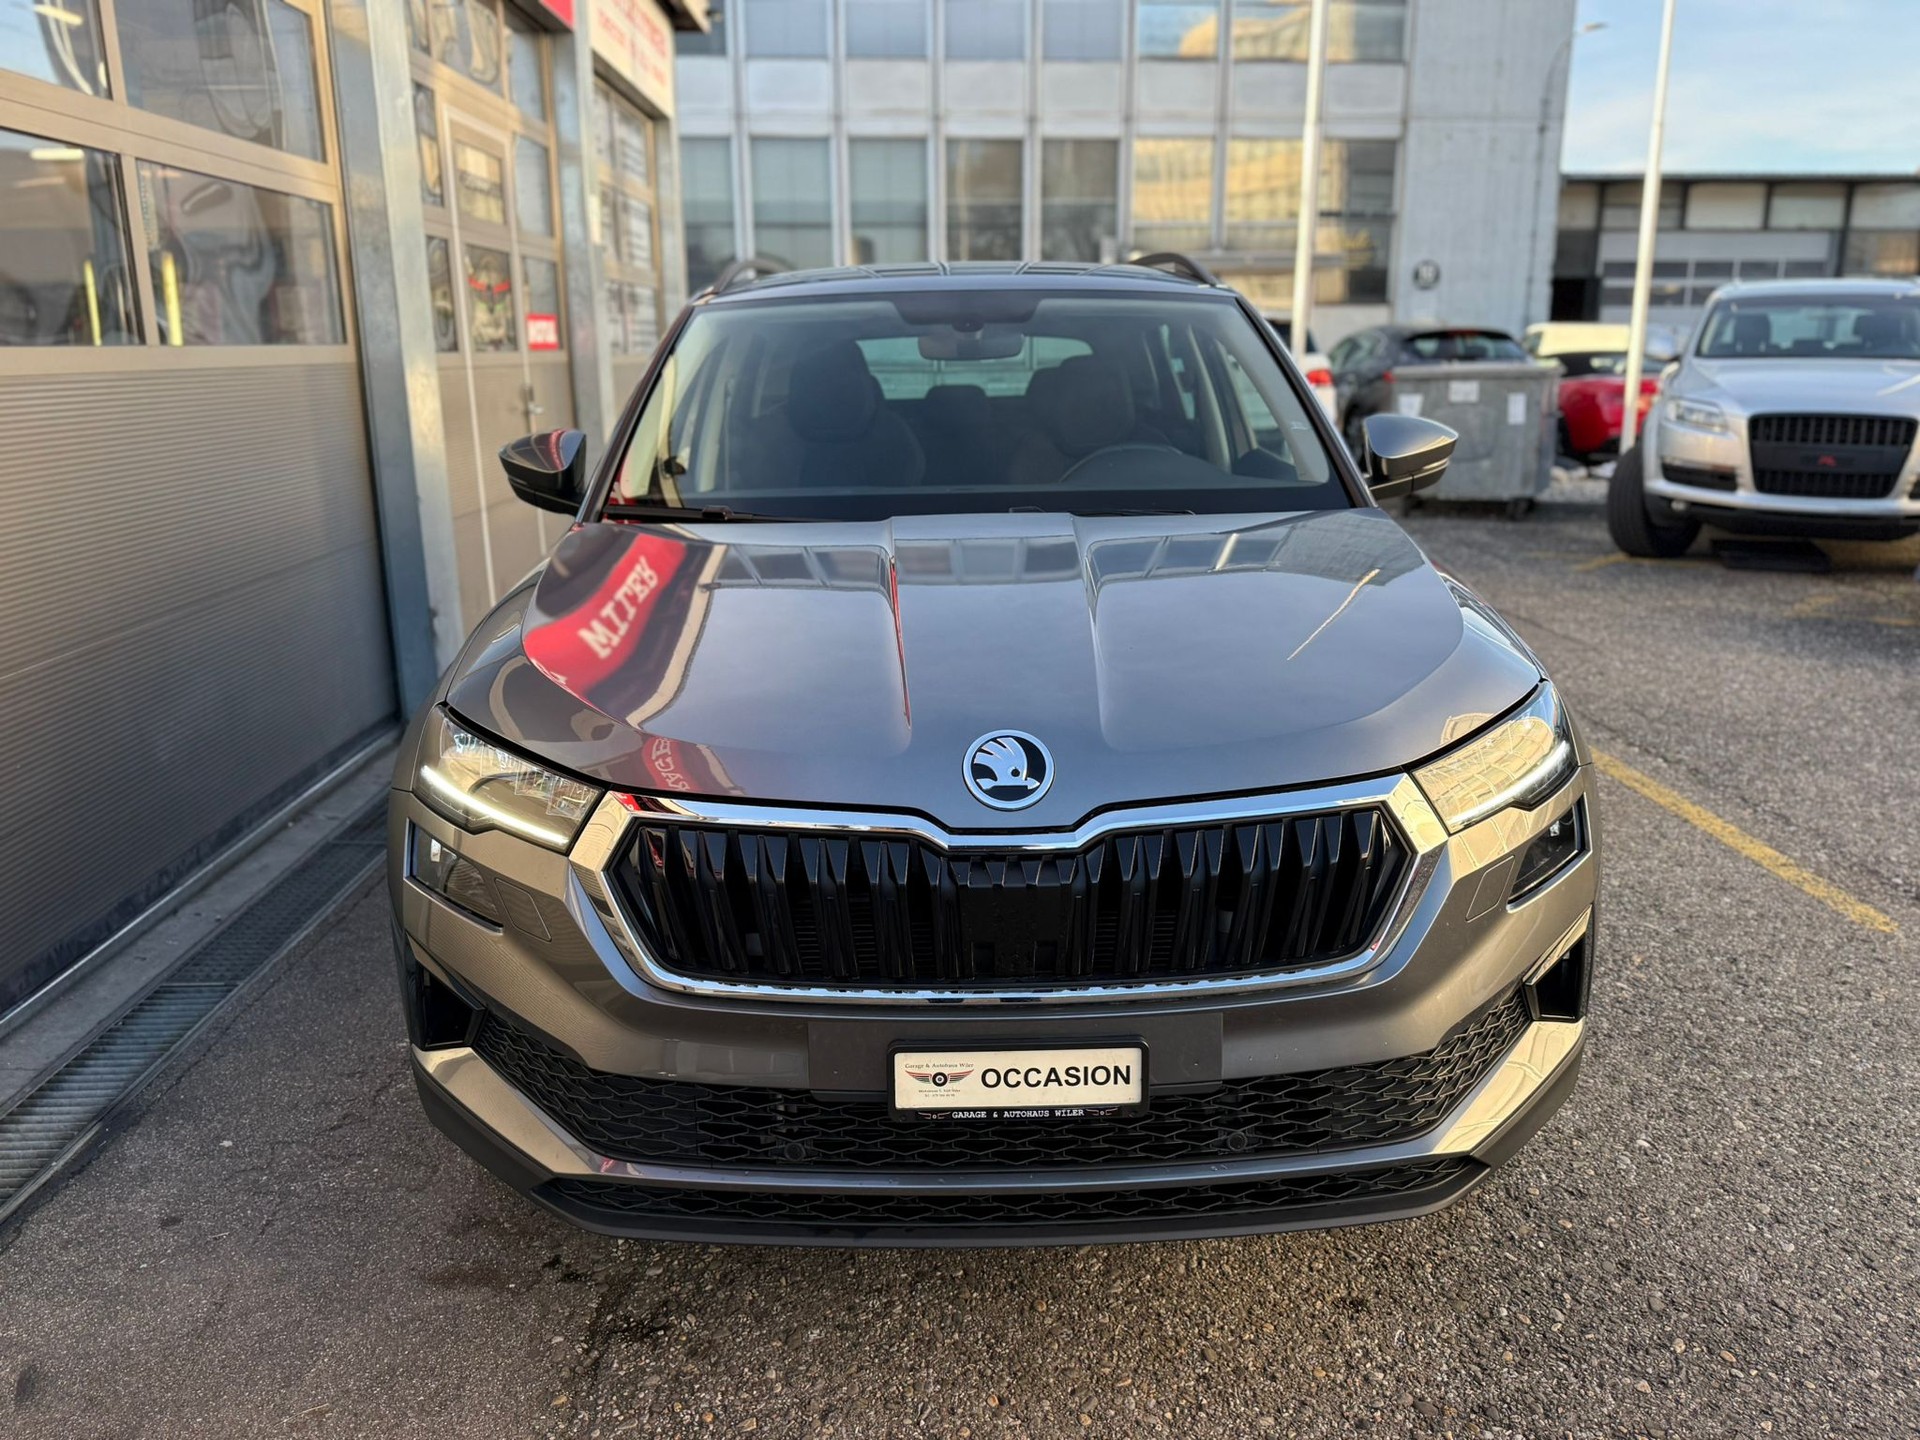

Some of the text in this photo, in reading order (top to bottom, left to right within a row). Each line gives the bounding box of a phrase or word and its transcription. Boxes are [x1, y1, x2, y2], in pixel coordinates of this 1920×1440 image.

[981, 1065, 1131, 1088] OCCASION
[952, 1111, 987, 1119] GARAGE
[1003, 1110, 1050, 1118] AUTOHAUS
[1055, 1109, 1085, 1117] WILER
